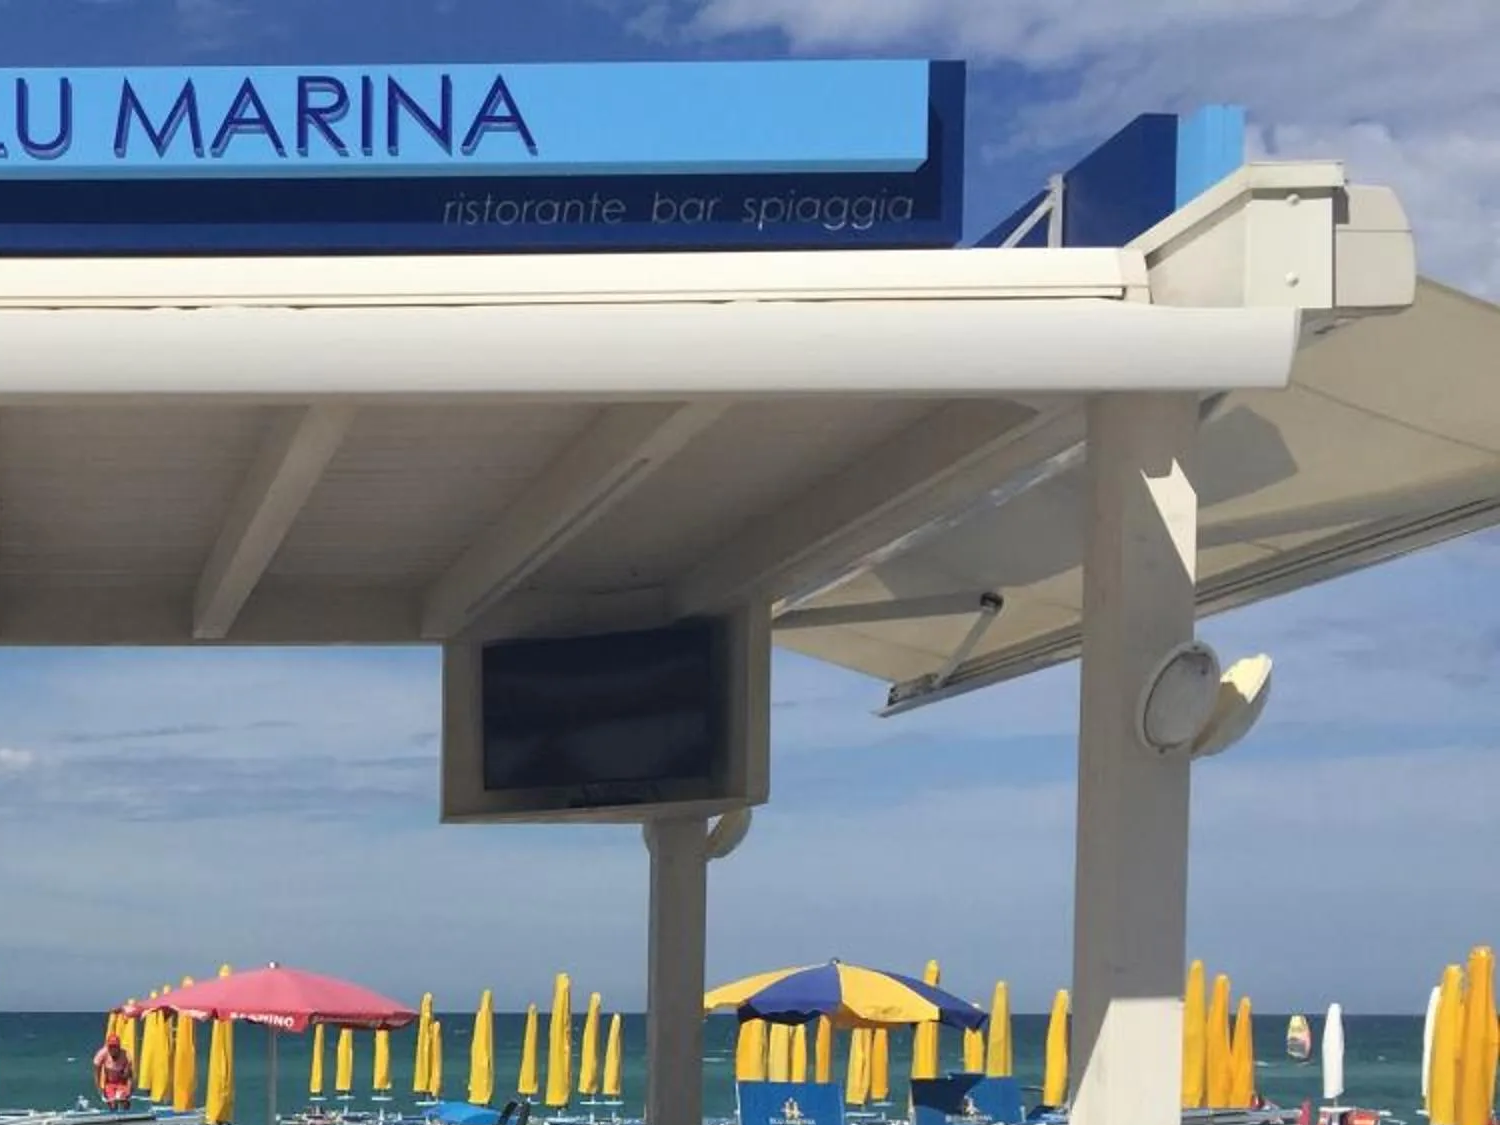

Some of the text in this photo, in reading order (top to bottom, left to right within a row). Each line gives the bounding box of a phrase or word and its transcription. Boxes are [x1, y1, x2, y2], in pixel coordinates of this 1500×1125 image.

[113, 74, 539, 159] MARINA
[443, 188, 915, 231] ristorante bar spiaggia
